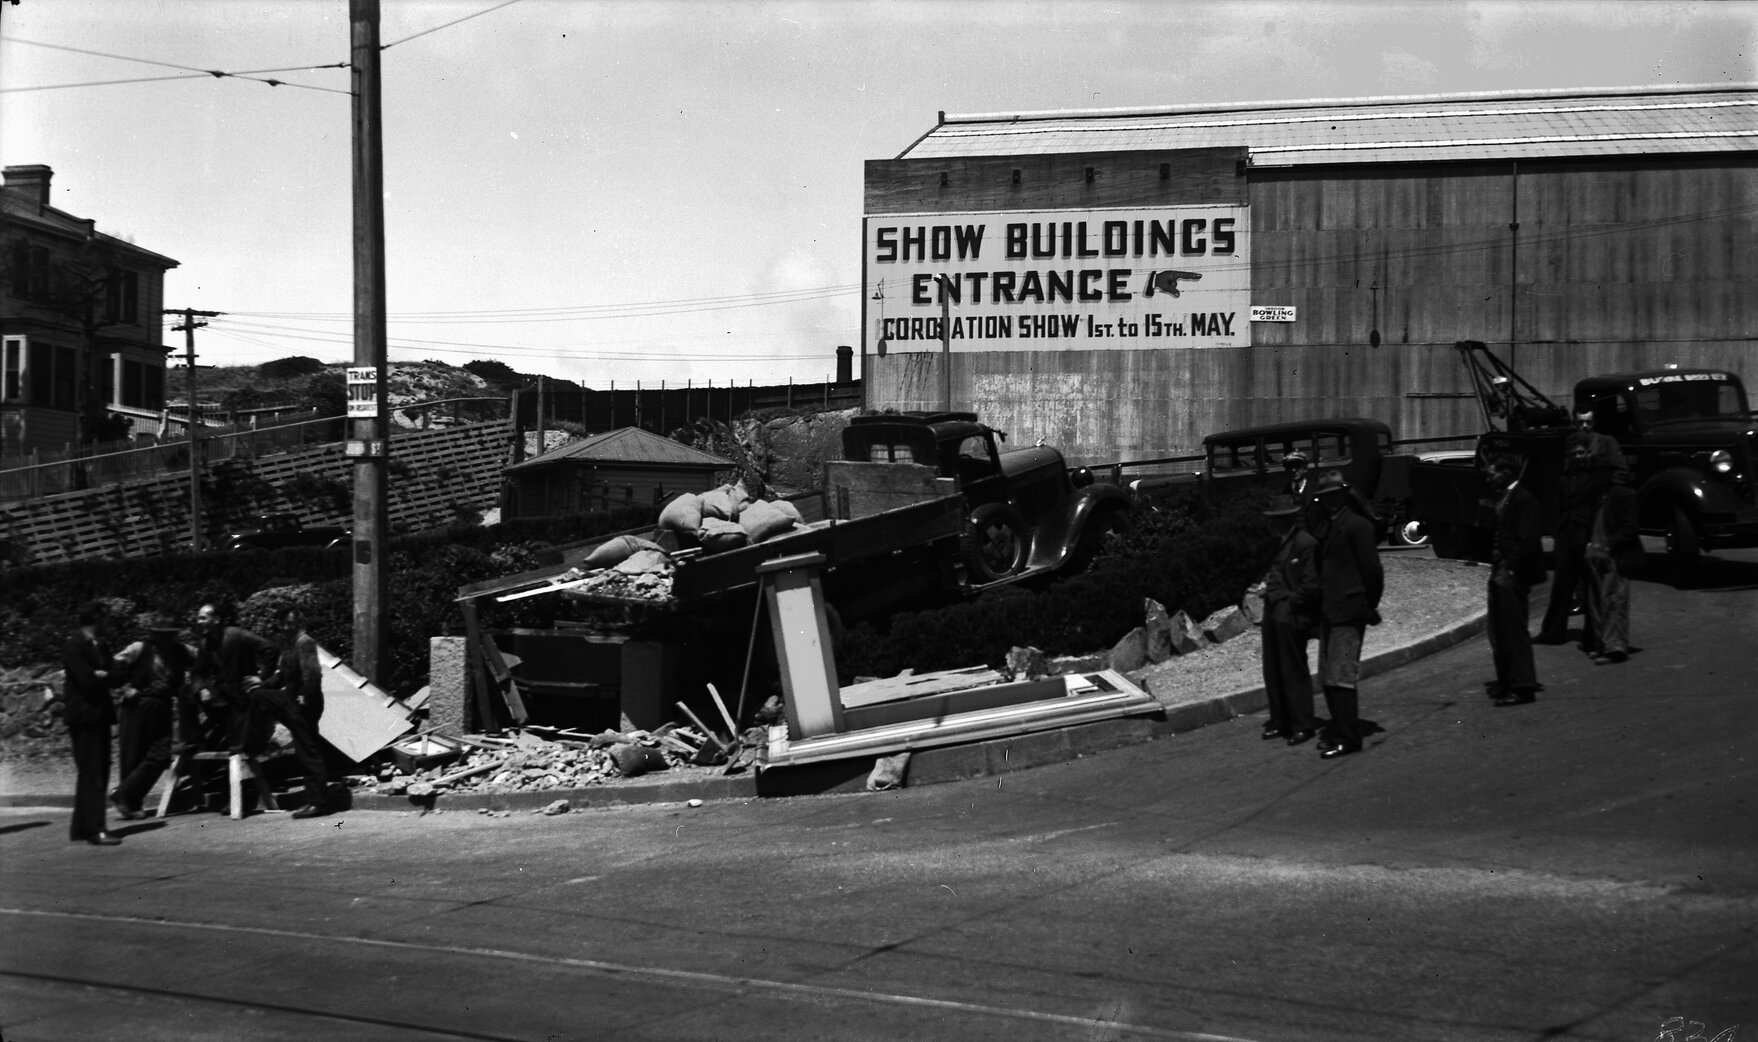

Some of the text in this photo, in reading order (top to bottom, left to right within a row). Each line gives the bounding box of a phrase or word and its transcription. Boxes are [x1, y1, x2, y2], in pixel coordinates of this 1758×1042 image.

[876, 217, 1236, 263] SHOW BUILDINGS
[911, 268, 1133, 305] ENTRANCE
[1018, 313, 1080, 339] SHOW
[1117, 317, 1139, 338] to
[1144, 313, 1188, 338] 15TH.
[1190, 311, 1236, 337] MAY.
